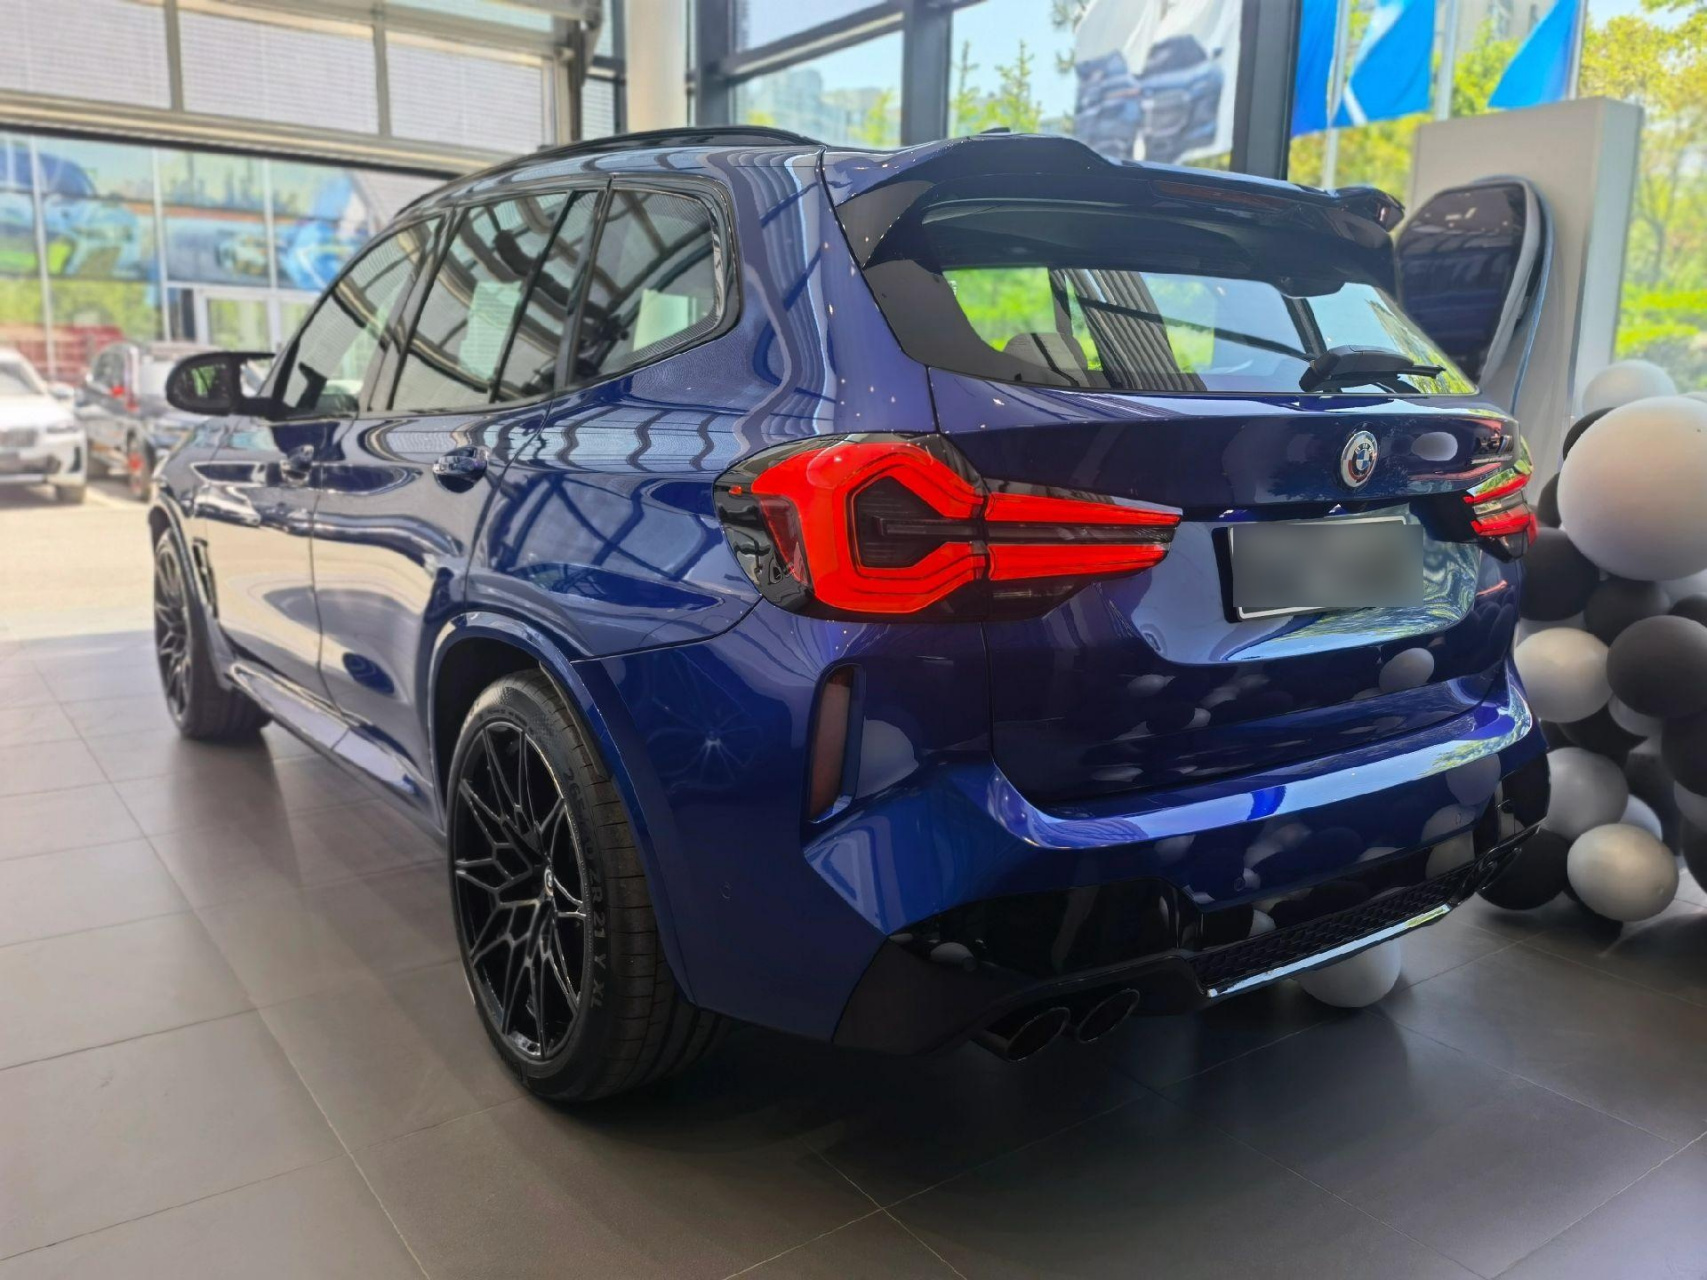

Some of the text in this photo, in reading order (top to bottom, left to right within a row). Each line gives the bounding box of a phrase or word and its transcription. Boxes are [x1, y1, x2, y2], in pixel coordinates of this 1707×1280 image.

[1354, 442, 1373, 455] BMW
[593, 952, 607, 970] Y
[589, 978, 606, 1009] XL
